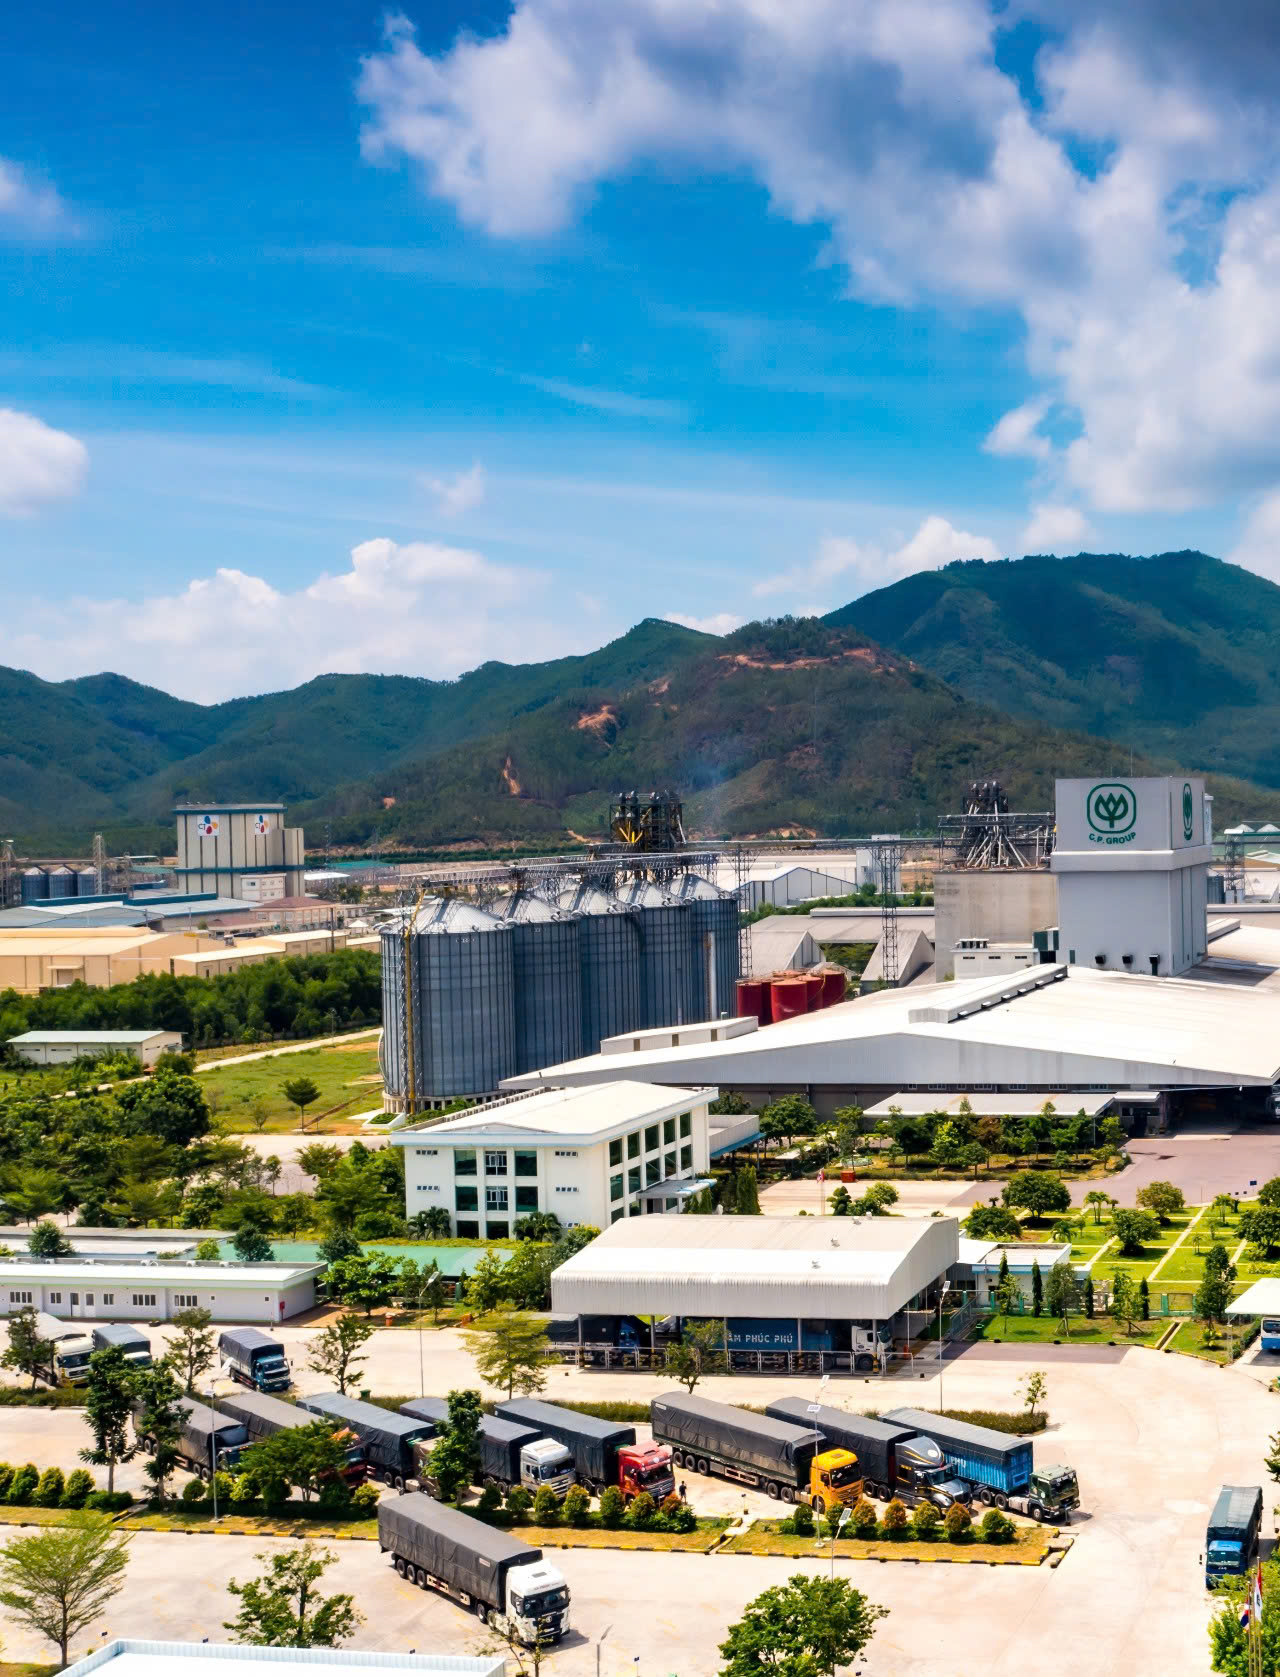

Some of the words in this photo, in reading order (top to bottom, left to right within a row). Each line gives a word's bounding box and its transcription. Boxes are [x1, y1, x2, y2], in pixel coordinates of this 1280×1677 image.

[1089, 833, 1104, 844] C.P.
[1106, 832, 1136, 844] GROUP
[745, 1333, 770, 1343] PHÚC
[774, 1333, 794, 1344] PHÚ
